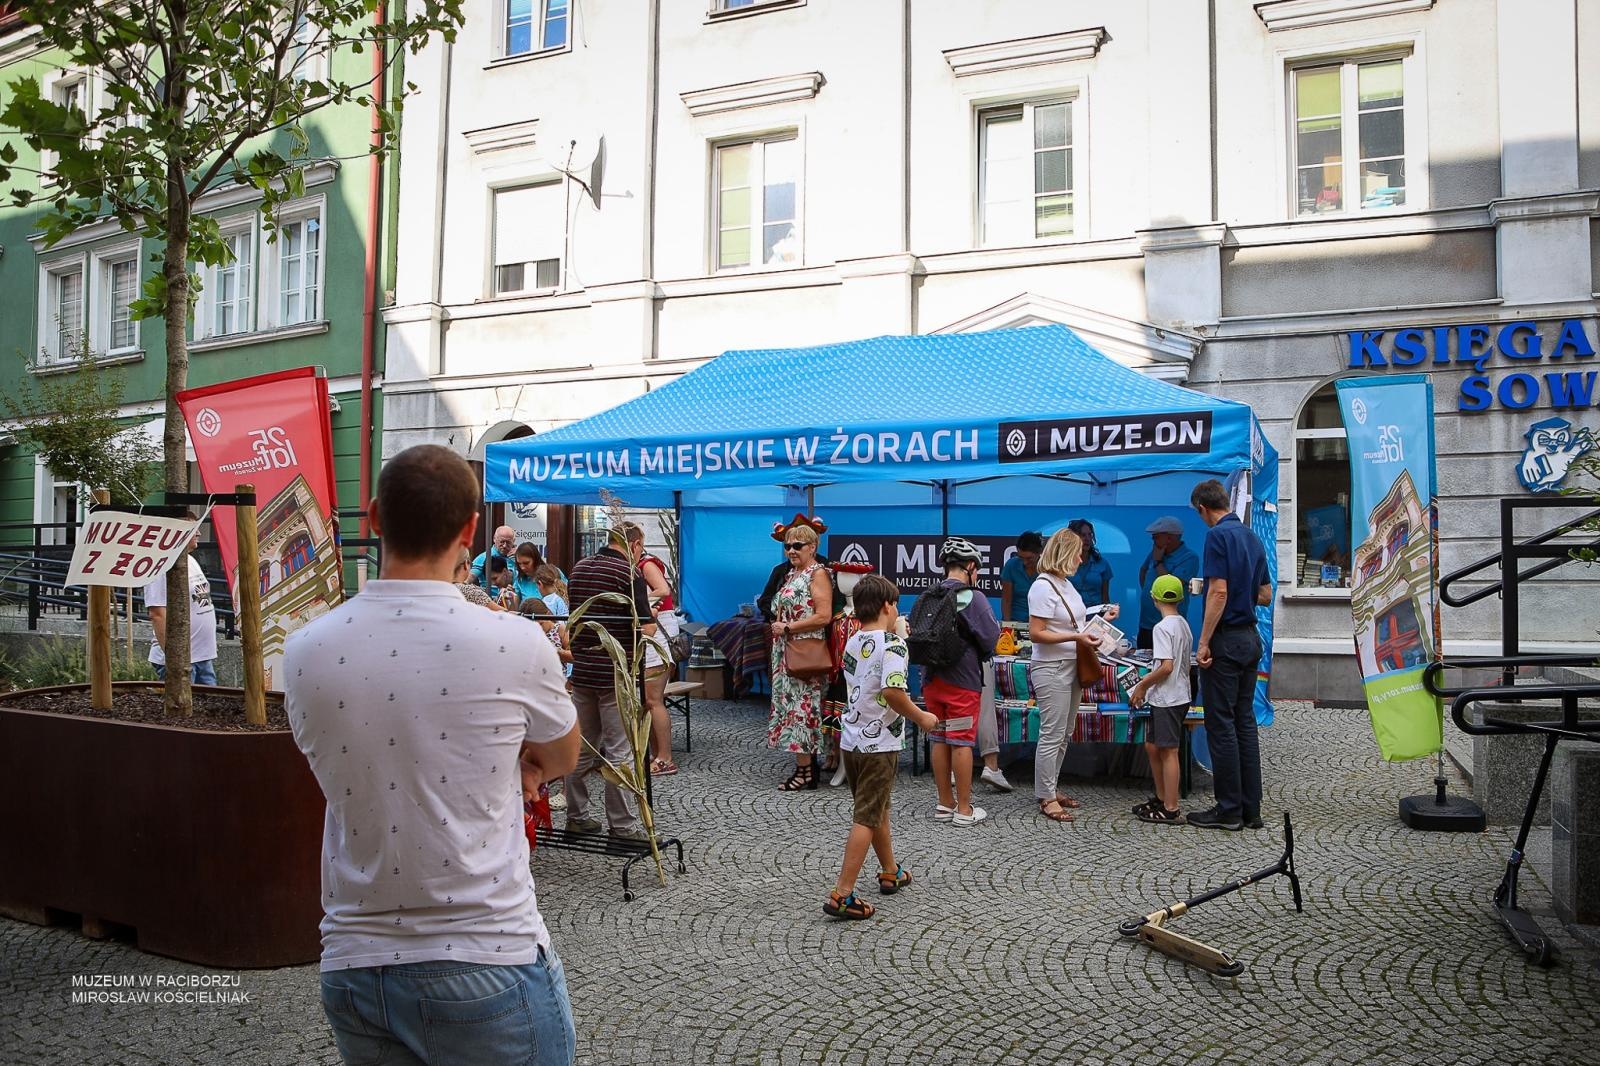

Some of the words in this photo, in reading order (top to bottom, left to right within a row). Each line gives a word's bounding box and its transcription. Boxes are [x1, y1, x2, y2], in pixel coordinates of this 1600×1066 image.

[1347, 319, 1596, 373] KSIĘGA
[1458, 371, 1600, 411] SOW
[508, 448, 631, 484] MUZEUM
[639, 438, 775, 480] MIEJSKIE
[783, 435, 819, 467] W
[828, 426, 979, 465] ŻORACH
[1049, 419, 1204, 454] MUZE.ON
[81, 550, 102, 574] Z
